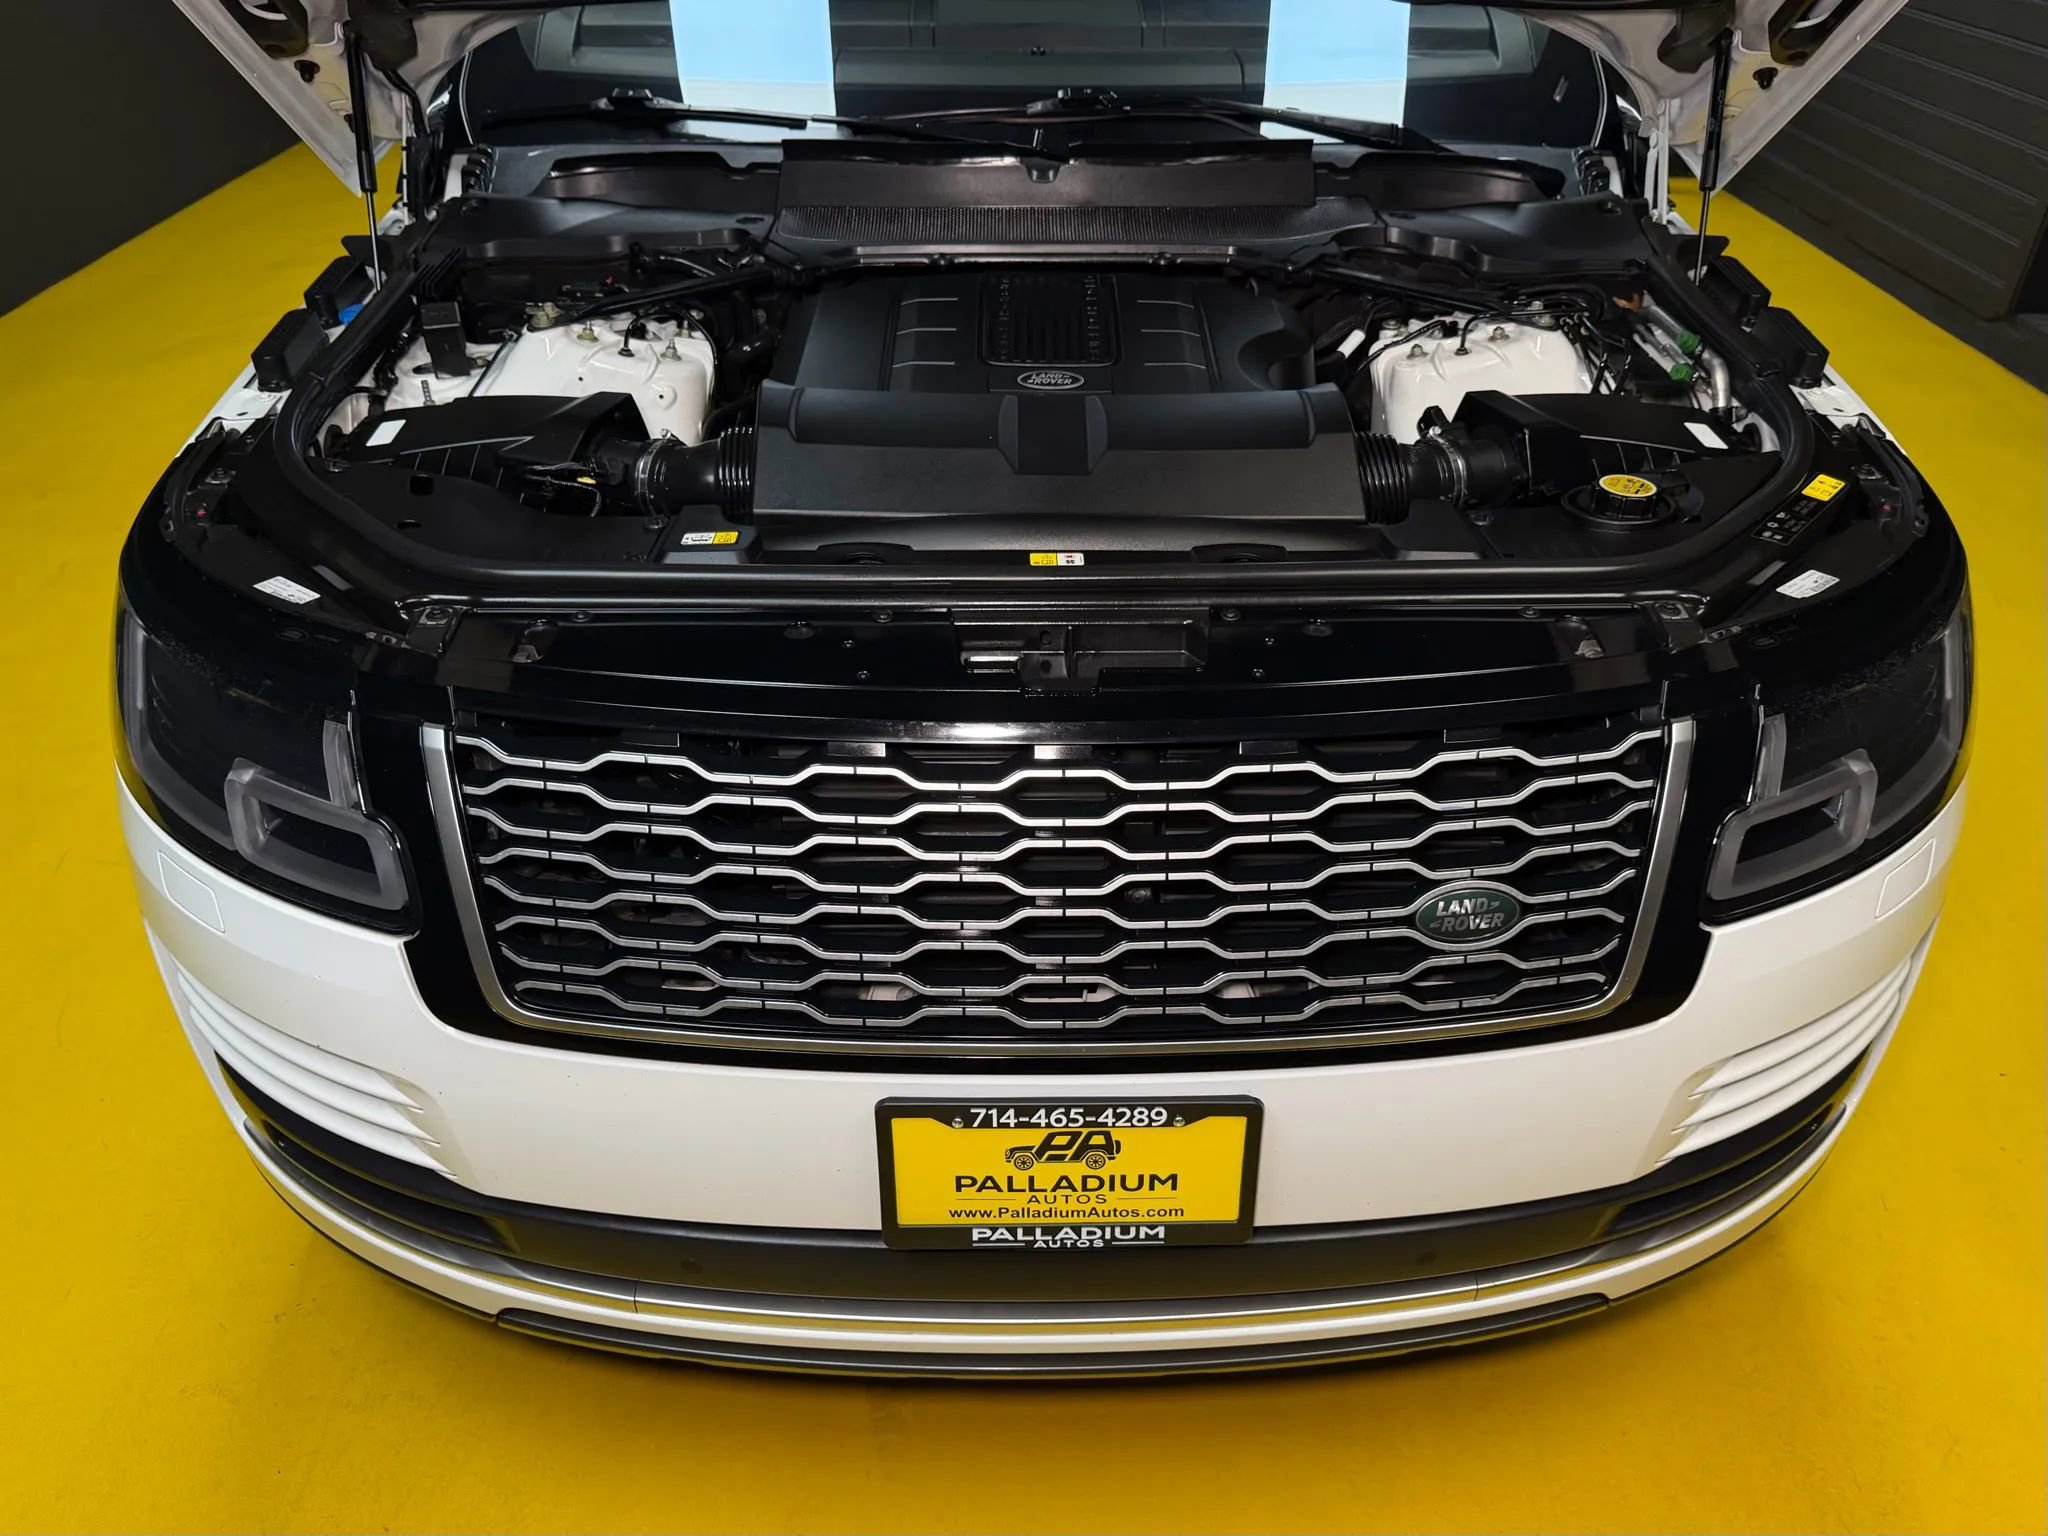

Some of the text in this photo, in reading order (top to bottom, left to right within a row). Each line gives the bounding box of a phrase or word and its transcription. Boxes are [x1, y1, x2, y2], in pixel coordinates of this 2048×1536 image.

[1436, 898, 1488, 916] LAND
[1441, 913, 1504, 932] ROVER
[969, 1107, 1168, 1128] 714-465-4289
[954, 1173, 1179, 1193] PALLADIUM
[1026, 1193, 1108, 1205] AUTOS
[948, 1206, 1184, 1219] www.PalladiumAutos.com
[972, 1226, 1165, 1241] PALLADIUM
[1033, 1239, 1104, 1248] AUTOS
